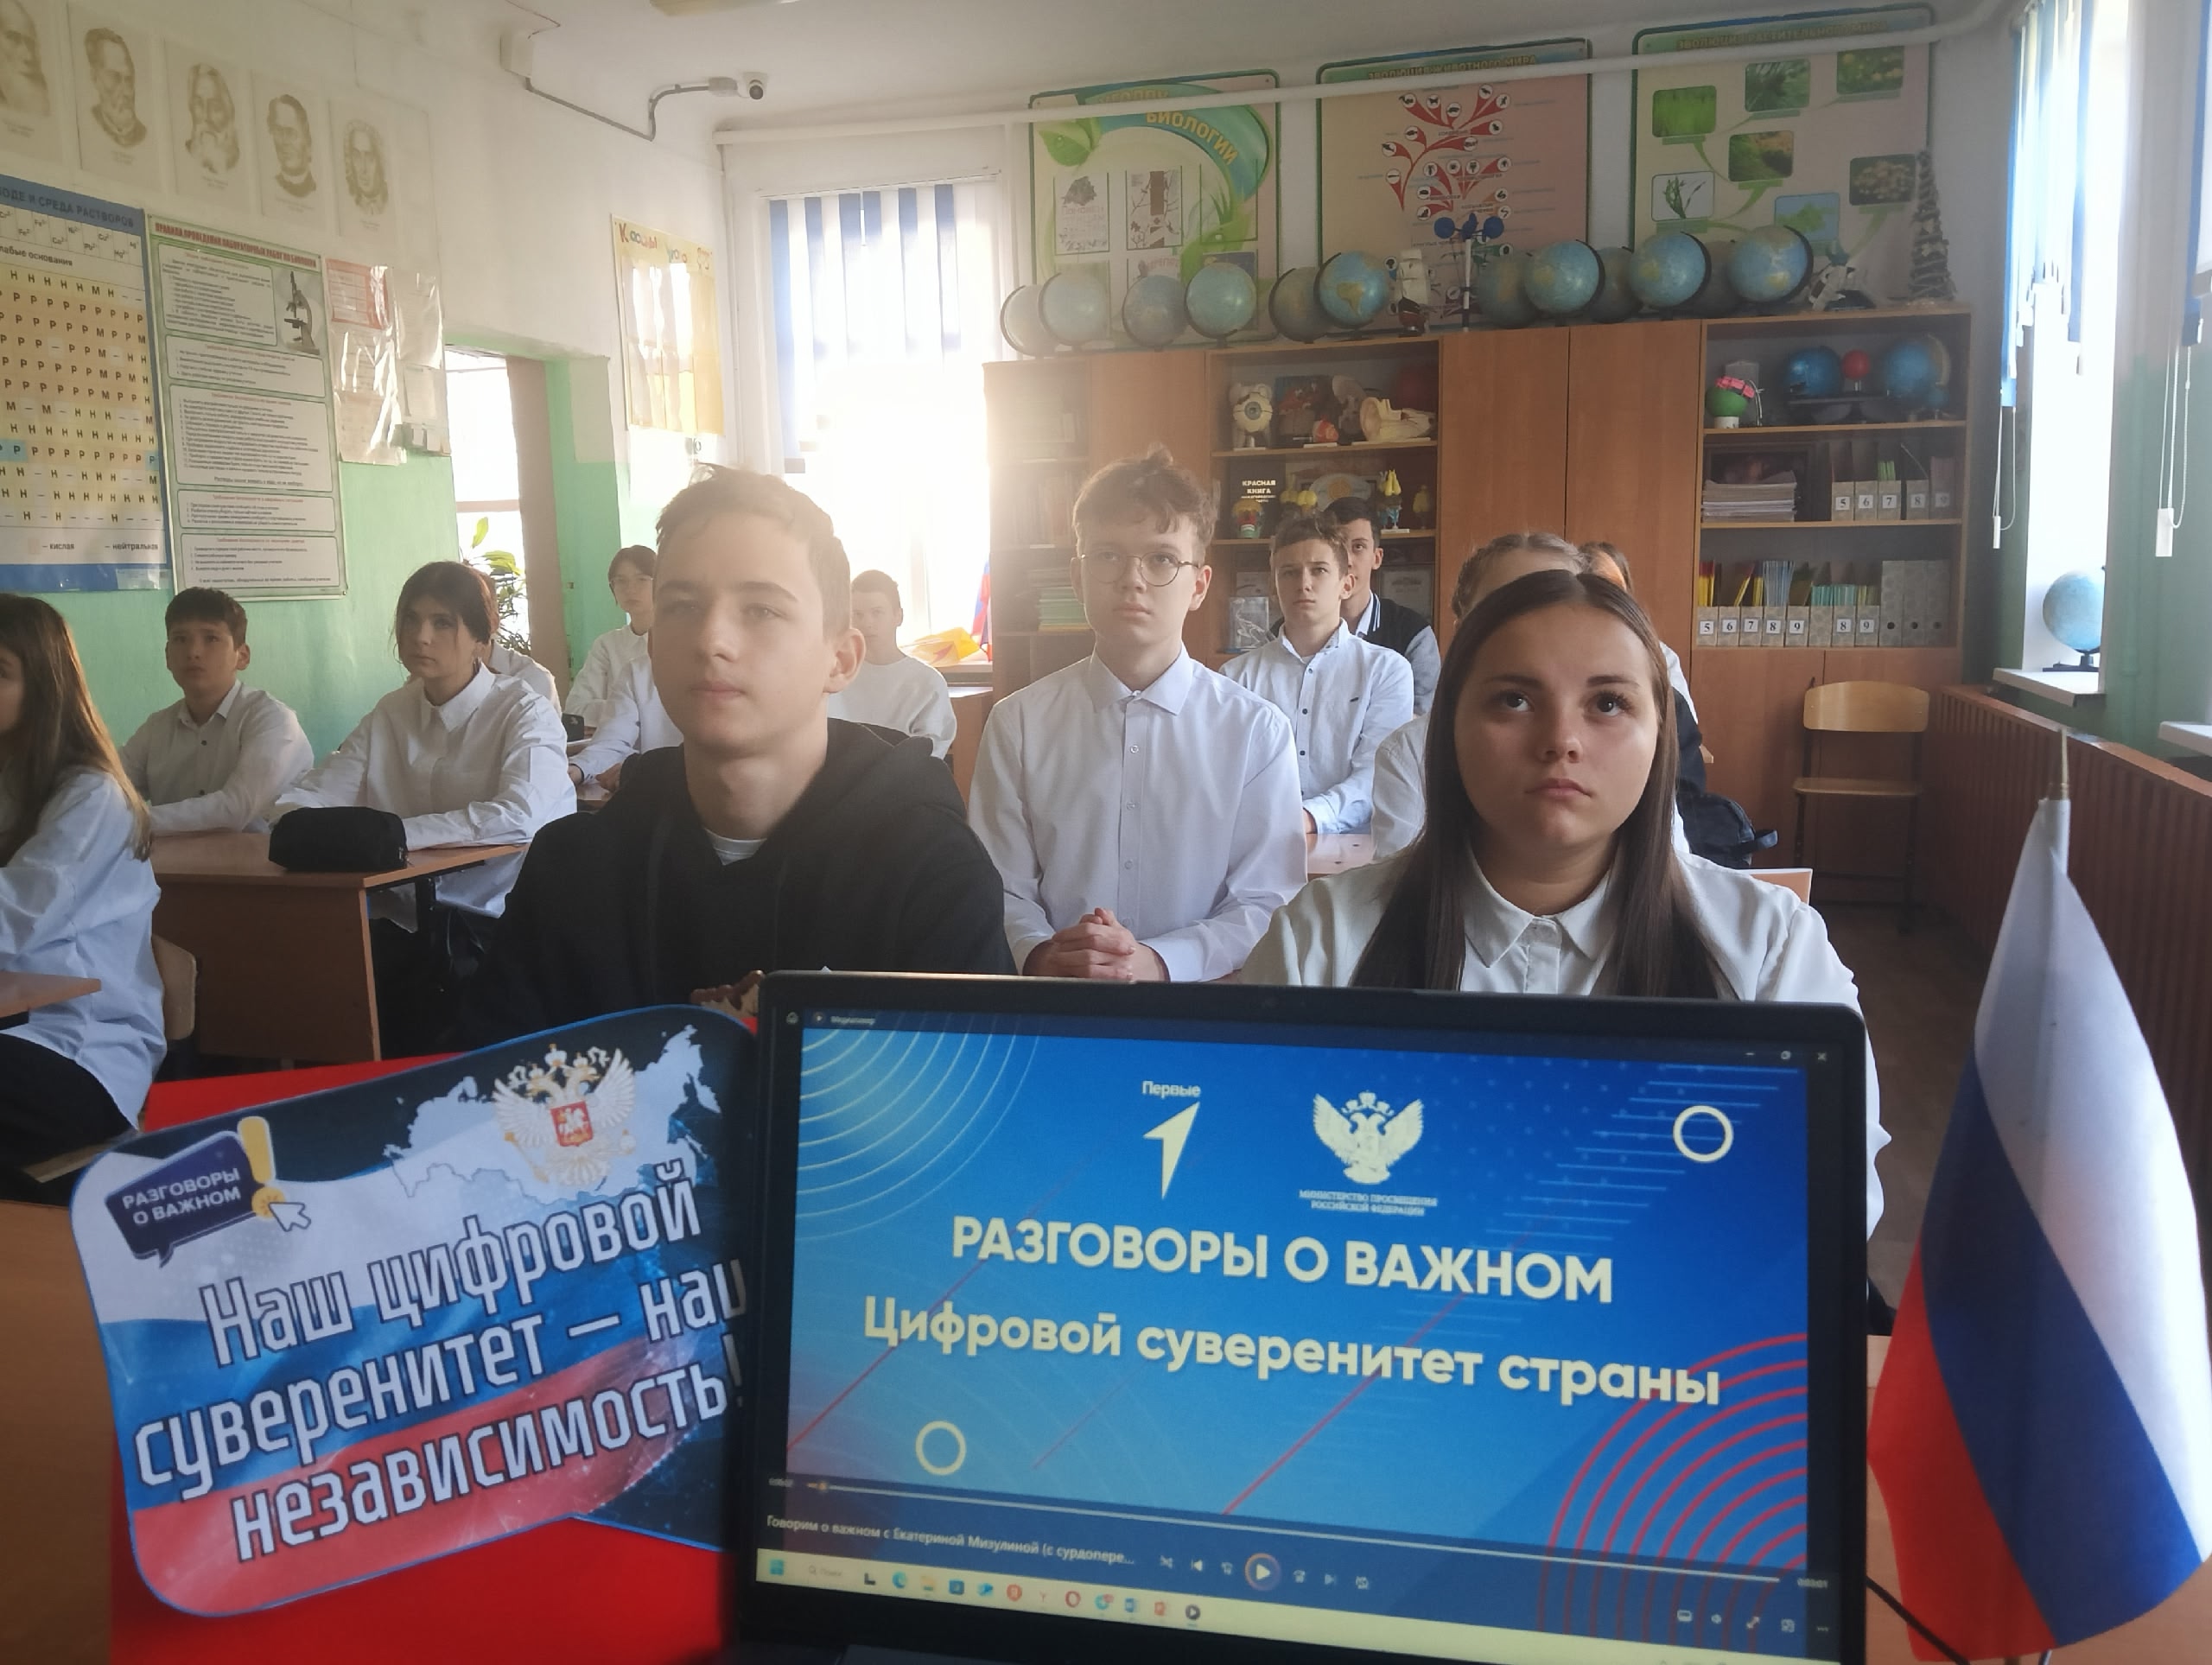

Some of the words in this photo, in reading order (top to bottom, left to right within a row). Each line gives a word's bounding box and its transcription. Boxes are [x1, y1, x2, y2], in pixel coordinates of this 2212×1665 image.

[1146, 111, 1238, 165] БИОЛОГИИ
[38, 197, 74, 214] СРЕДА
[77, 206, 134, 228] РАСТВОРОВ
[29, 251, 73, 266] основания
[10, 270, 17, 280] Н
[28, 274, 35, 283] Н
[44, 276, 51, 286] Н
[60, 280, 67, 289] Н
[76, 283, 83, 292] Н
[92, 285, 100, 296] М
[108, 289, 114, 297] Н
[14, 292, 20, 302] Р
[30, 296, 37, 304] Р
[47, 298, 53, 308] Р
[63, 301, 69, 310] Р
[79, 304, 86, 313] Р
[95, 307, 102, 315] Р
[111, 309, 116, 318] Р
[124, 312, 130, 321] Р
[137, 315, 143, 323] Р
[16, 315, 22, 323] Р
[33, 318, 40, 327] Р
[49, 320, 56, 329] Р
[67, 322, 73, 332] Р
[82, 325, 88, 334] Р
[97, 327, 104, 337] М
[111, 330, 118, 339] Р
[126, 333, 130, 341] Р
[138, 335, 145, 344] М
[0, 334, 7, 344] Р
[18, 337, 25, 346] Р
[35, 340, 41, 348] Р
[69, 344, 75, 353] Р
[85, 346, 90, 355] Р
[99, 349, 105, 358] М
[128, 353, 133, 362] Н
[141, 355, 147, 365] Н
[2, 356, 9, 365] Р
[21, 359, 27, 368] Р
[38, 361, 44, 370] Р
[55, 363, 62, 372] Р
[86, 367, 92, 376] Р
[99, 370, 107, 378] М
[116, 372, 122, 380] Р
[129, 373, 136, 382] М
[143, 376, 149, 384] Н
[4, 378, 11, 388] Р
[22, 381, 29, 390] Р
[40, 383, 47, 392] Р
[58, 384, 64, 394] Р
[73, 387, 79, 396] Р
[88, 389, 94, 397] Р
[102, 391, 110, 399] М
[118, 392, 123, 401] Р
[6, 401, 16, 411] М
[41, 404, 51, 415] М
[75, 408, 81, 417] Н
[90, 410, 96, 418] Н
[105, 411, 111, 420] Н
[146, 416, 153, 424] М
[10, 423, 18, 433] Н
[29, 425, 35, 434] Н
[46, 426, 53, 435] Н
[76, 429, 83, 438] Н
[92, 430, 99, 440] Н
[107, 432, 113, 441] Н
[122, 433, 127, 442] Н
[136, 434, 141, 442] Н
[149, 435, 154, 444] Н
[14, 445, 21, 454] Р
[31, 447, 38, 456] Р
[48, 448, 55, 456] Р
[64, 449, 69, 458] Р
[79, 450, 85, 459] Р
[94, 451, 100, 461] Р
[109, 453, 114, 461] Р
[136, 454, 142, 463] Р
[149, 456, 156, 465] Р
[1840, 499, 1847, 508] 5
[1863, 498, 1870, 506] 6
[1886, 497, 1892, 505] 7
[1915, 496, 1921, 505] 8
[1704, 623, 1710, 632] 5
[1726, 622, 1733, 631] 6
[1748, 620, 1754, 629] 7
[1770, 622, 1777, 631] 8
[1794, 622, 1801, 631] 9
[1840, 622, 1847, 631] 8
[1142, 1080, 1201, 1099] Первые
[122, 1167, 241, 1209] РАЗГОВОРЫ
[133, 1211, 149, 1224] О
[151, 1186, 241, 1221] ВАЖНОМ
[200, 1268, 353, 1366] Наш
[367, 1158, 701, 1329] цифровой
[953, 1215, 1268, 1279] РАЗГОВОРЫ
[1283, 1236, 1329, 1283] О
[1344, 1239, 1613, 1303] ВАЖНОМ
[864, 1295, 1122, 1357] Цифровой
[1136, 1325, 1484, 1385] суверенитет
[1497, 1354, 1719, 1406] страны
[134, 1313, 545, 1501] суверенитет
[232, 1334, 743, 1560] независимость!
[767, 1515, 818, 1532] Говорим
[821, 1523, 830, 1533] о
[832, 1523, 880, 1538] важном
[883, 1529, 890, 1539] с
[893, 1528, 964, 1547] Екатериной
[968, 1535, 1039, 1554] Мизулиной
